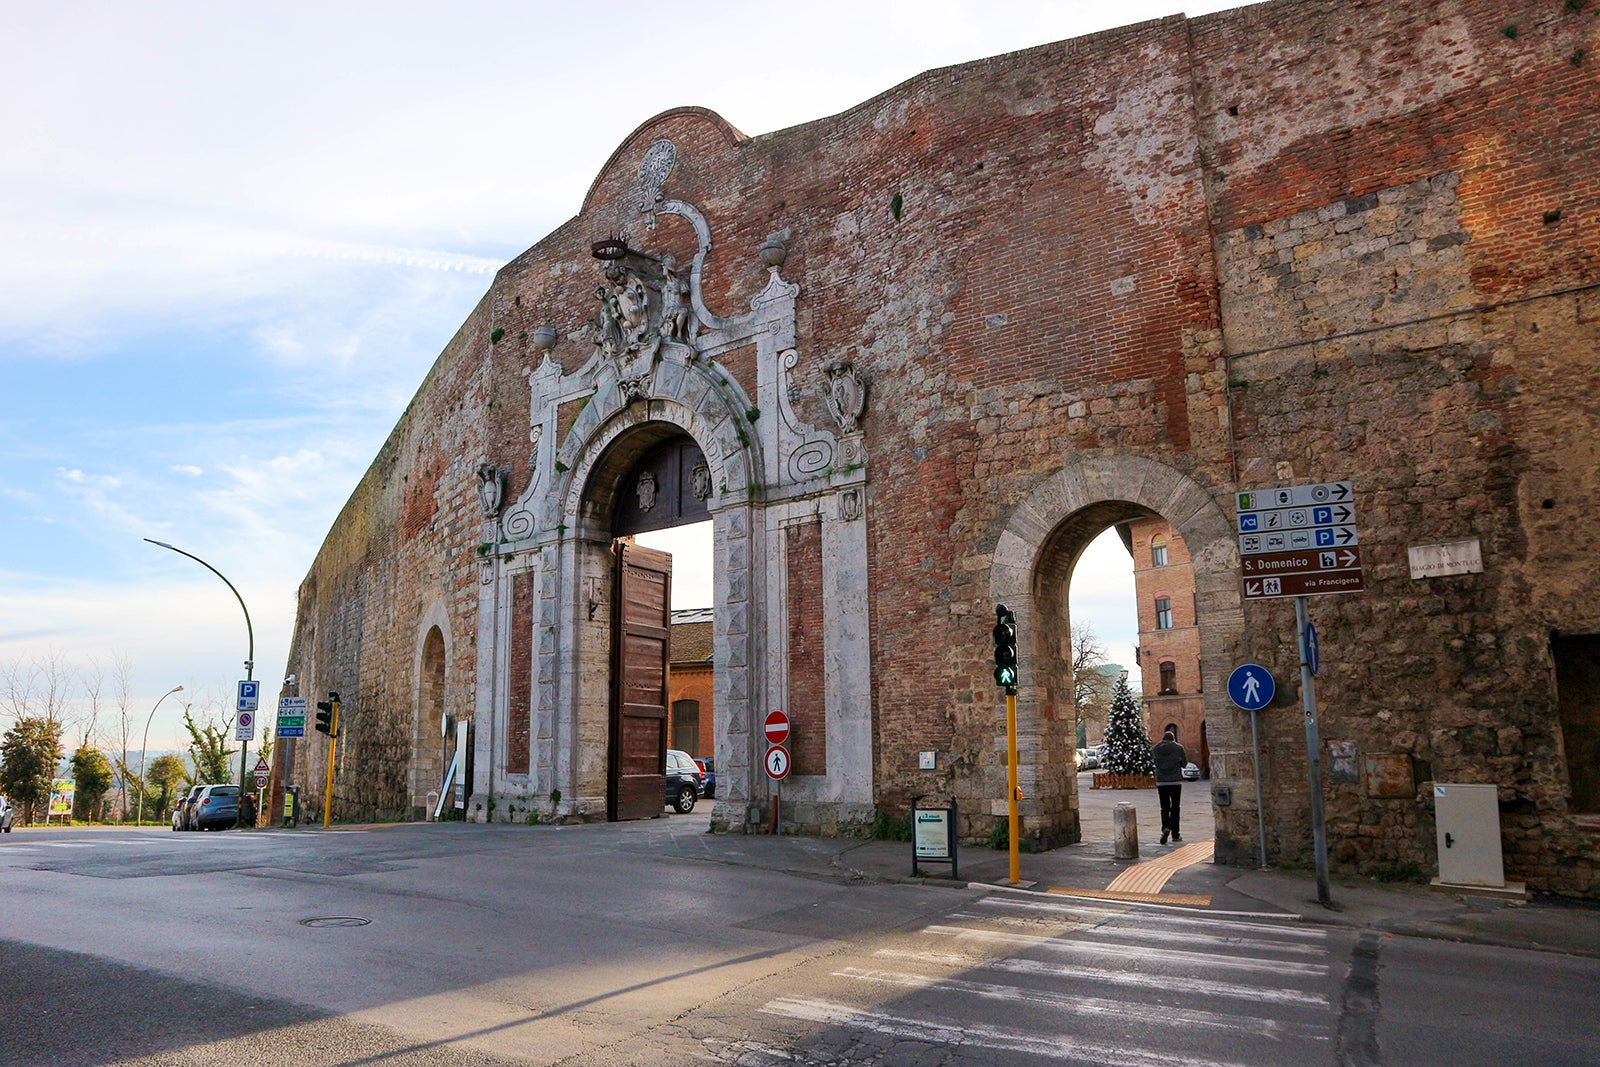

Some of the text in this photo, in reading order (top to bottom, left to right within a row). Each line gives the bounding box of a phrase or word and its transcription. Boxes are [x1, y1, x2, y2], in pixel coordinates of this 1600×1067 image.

[1318, 510, 1328, 522] P
[1320, 532, 1330, 544] P
[1245, 557, 1308, 570] S. Domenico
[1318, 577, 1360, 587] Francigena
[244, 685, 253, 696] P
